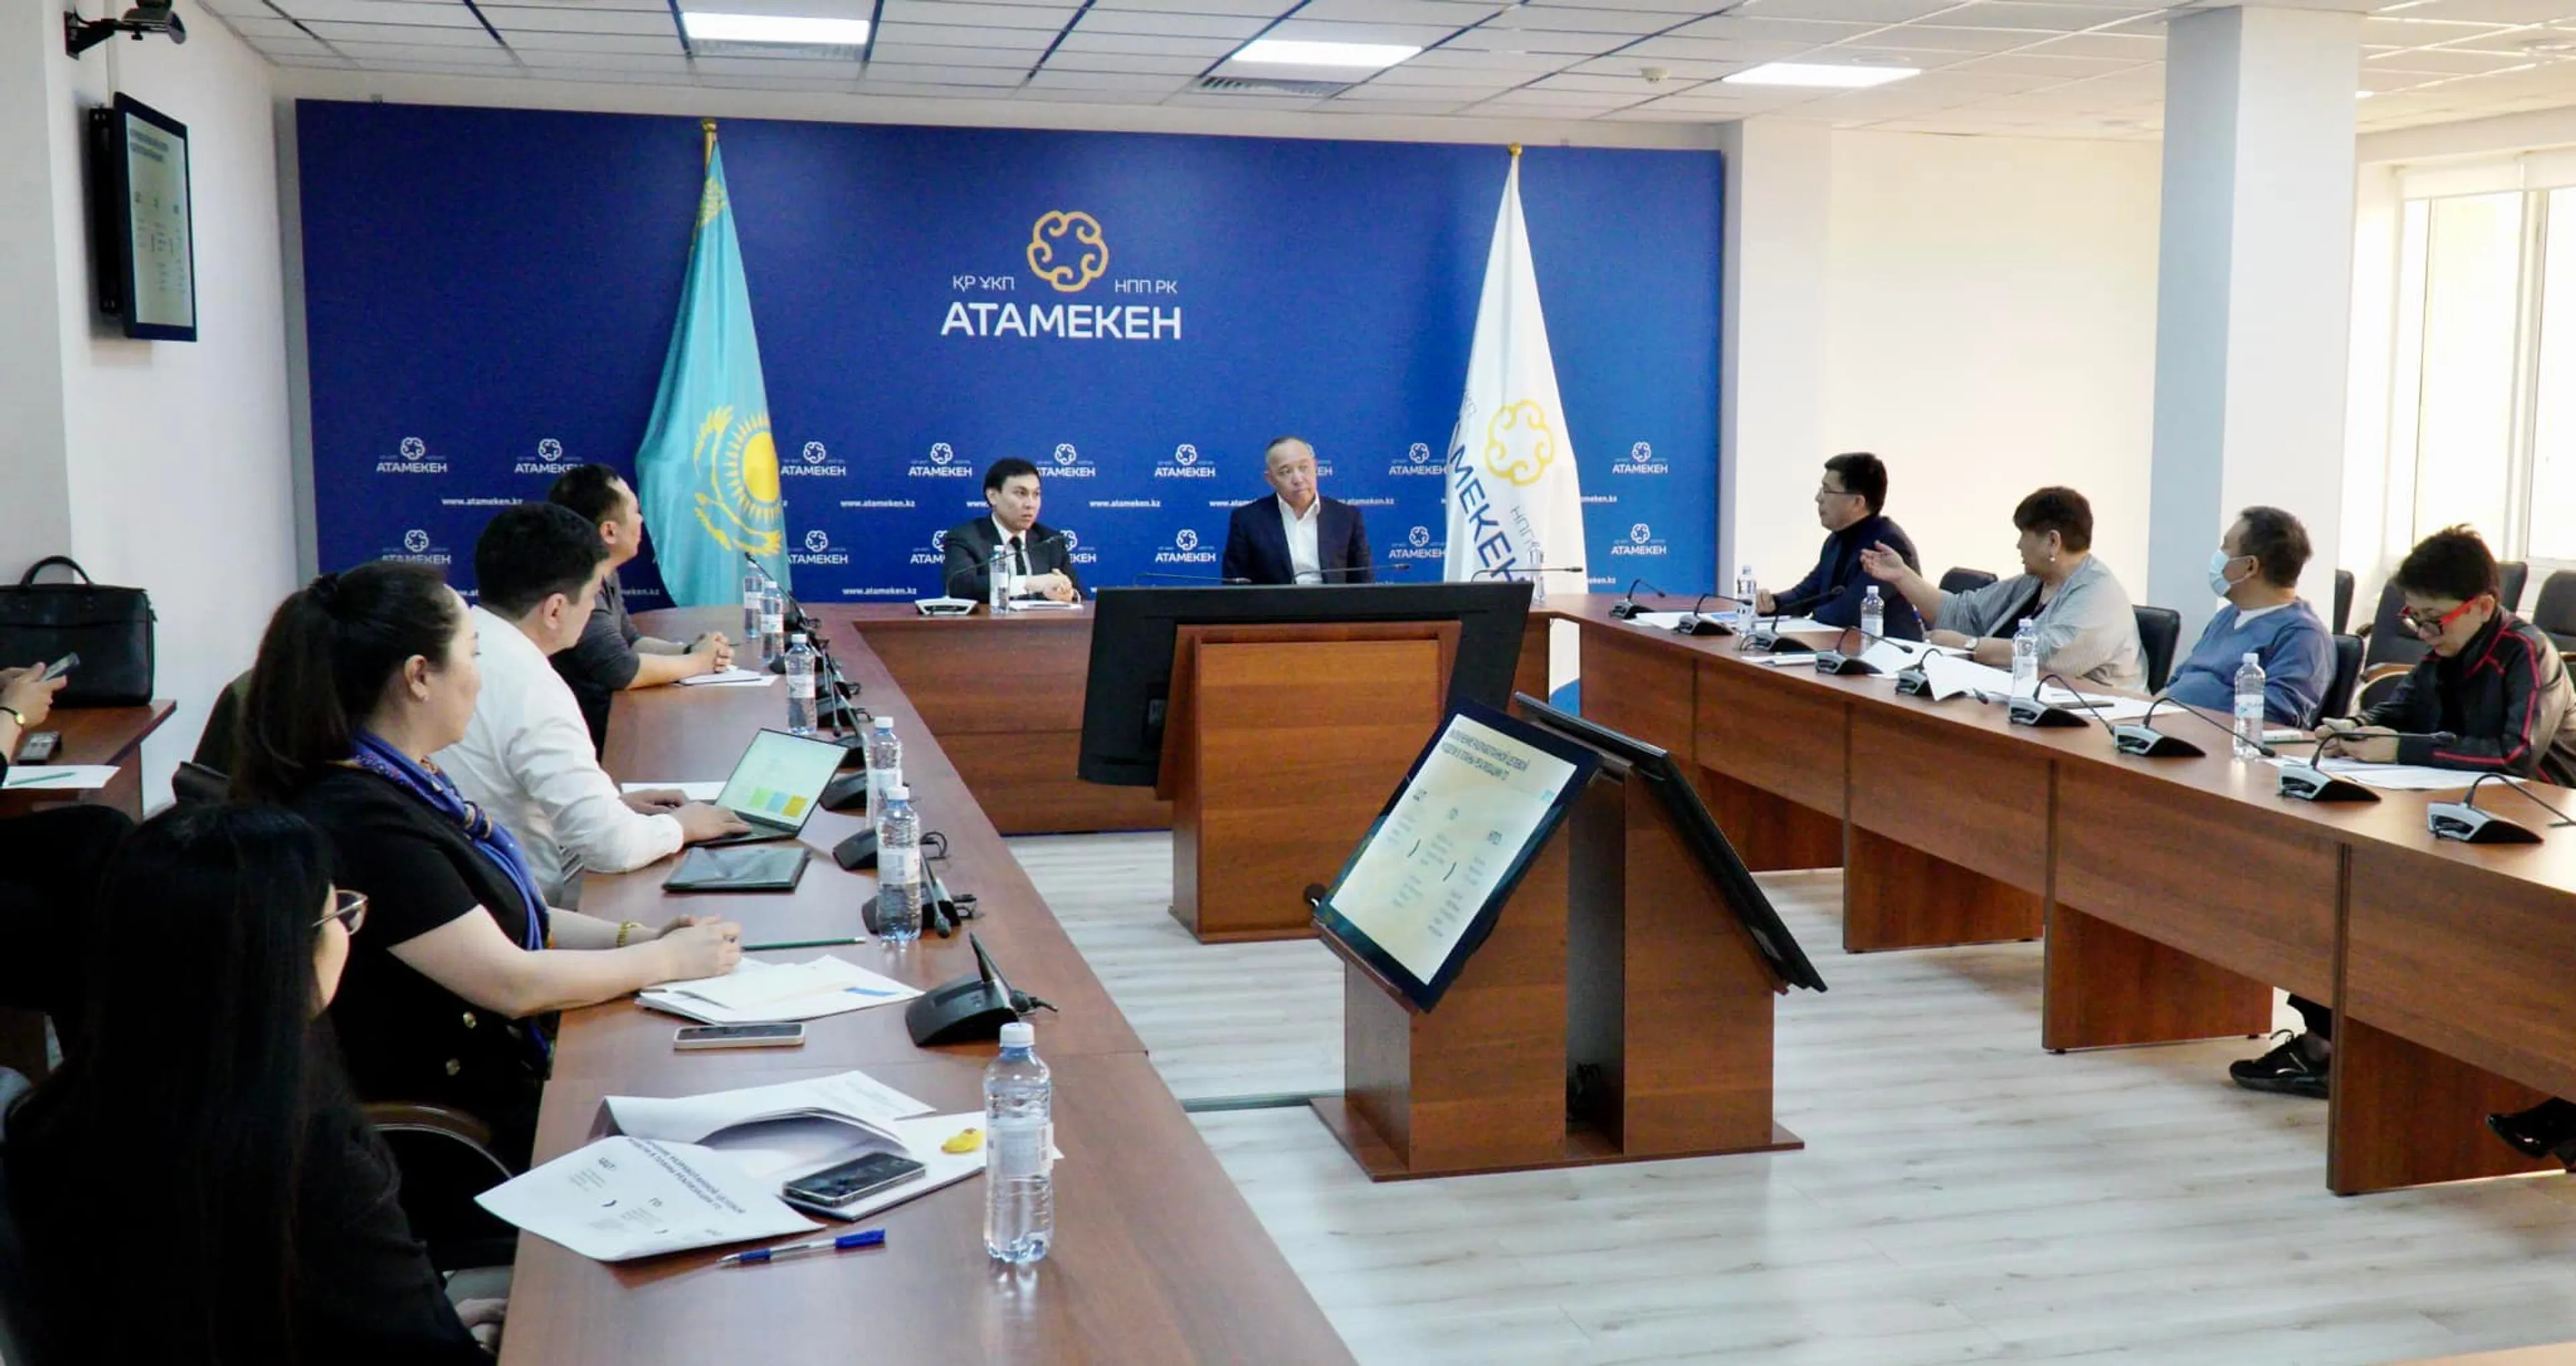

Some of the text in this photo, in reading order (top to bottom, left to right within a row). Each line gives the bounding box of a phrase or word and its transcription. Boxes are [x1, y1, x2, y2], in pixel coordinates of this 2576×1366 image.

[1115, 279, 1178, 294] НПП РК
[941, 301, 1182, 339] АТАМЕКЕН
[376, 462, 447, 473] АТАМЕКЕН
[780, 465, 846, 476] АТАМЕКЕН
[908, 466, 972, 477] АТАМЕКЕН
[1036, 467, 1096, 477] ТАМЕКЕН
[1155, 467, 1216, 477] АТАМЕКЕН
[1613, 464, 1668, 474] АТАМЕКЕН
[1611, 545, 1666, 555] АТАМЕКЕН
[1155, 551, 1216, 562] АТАМЕКЕН
